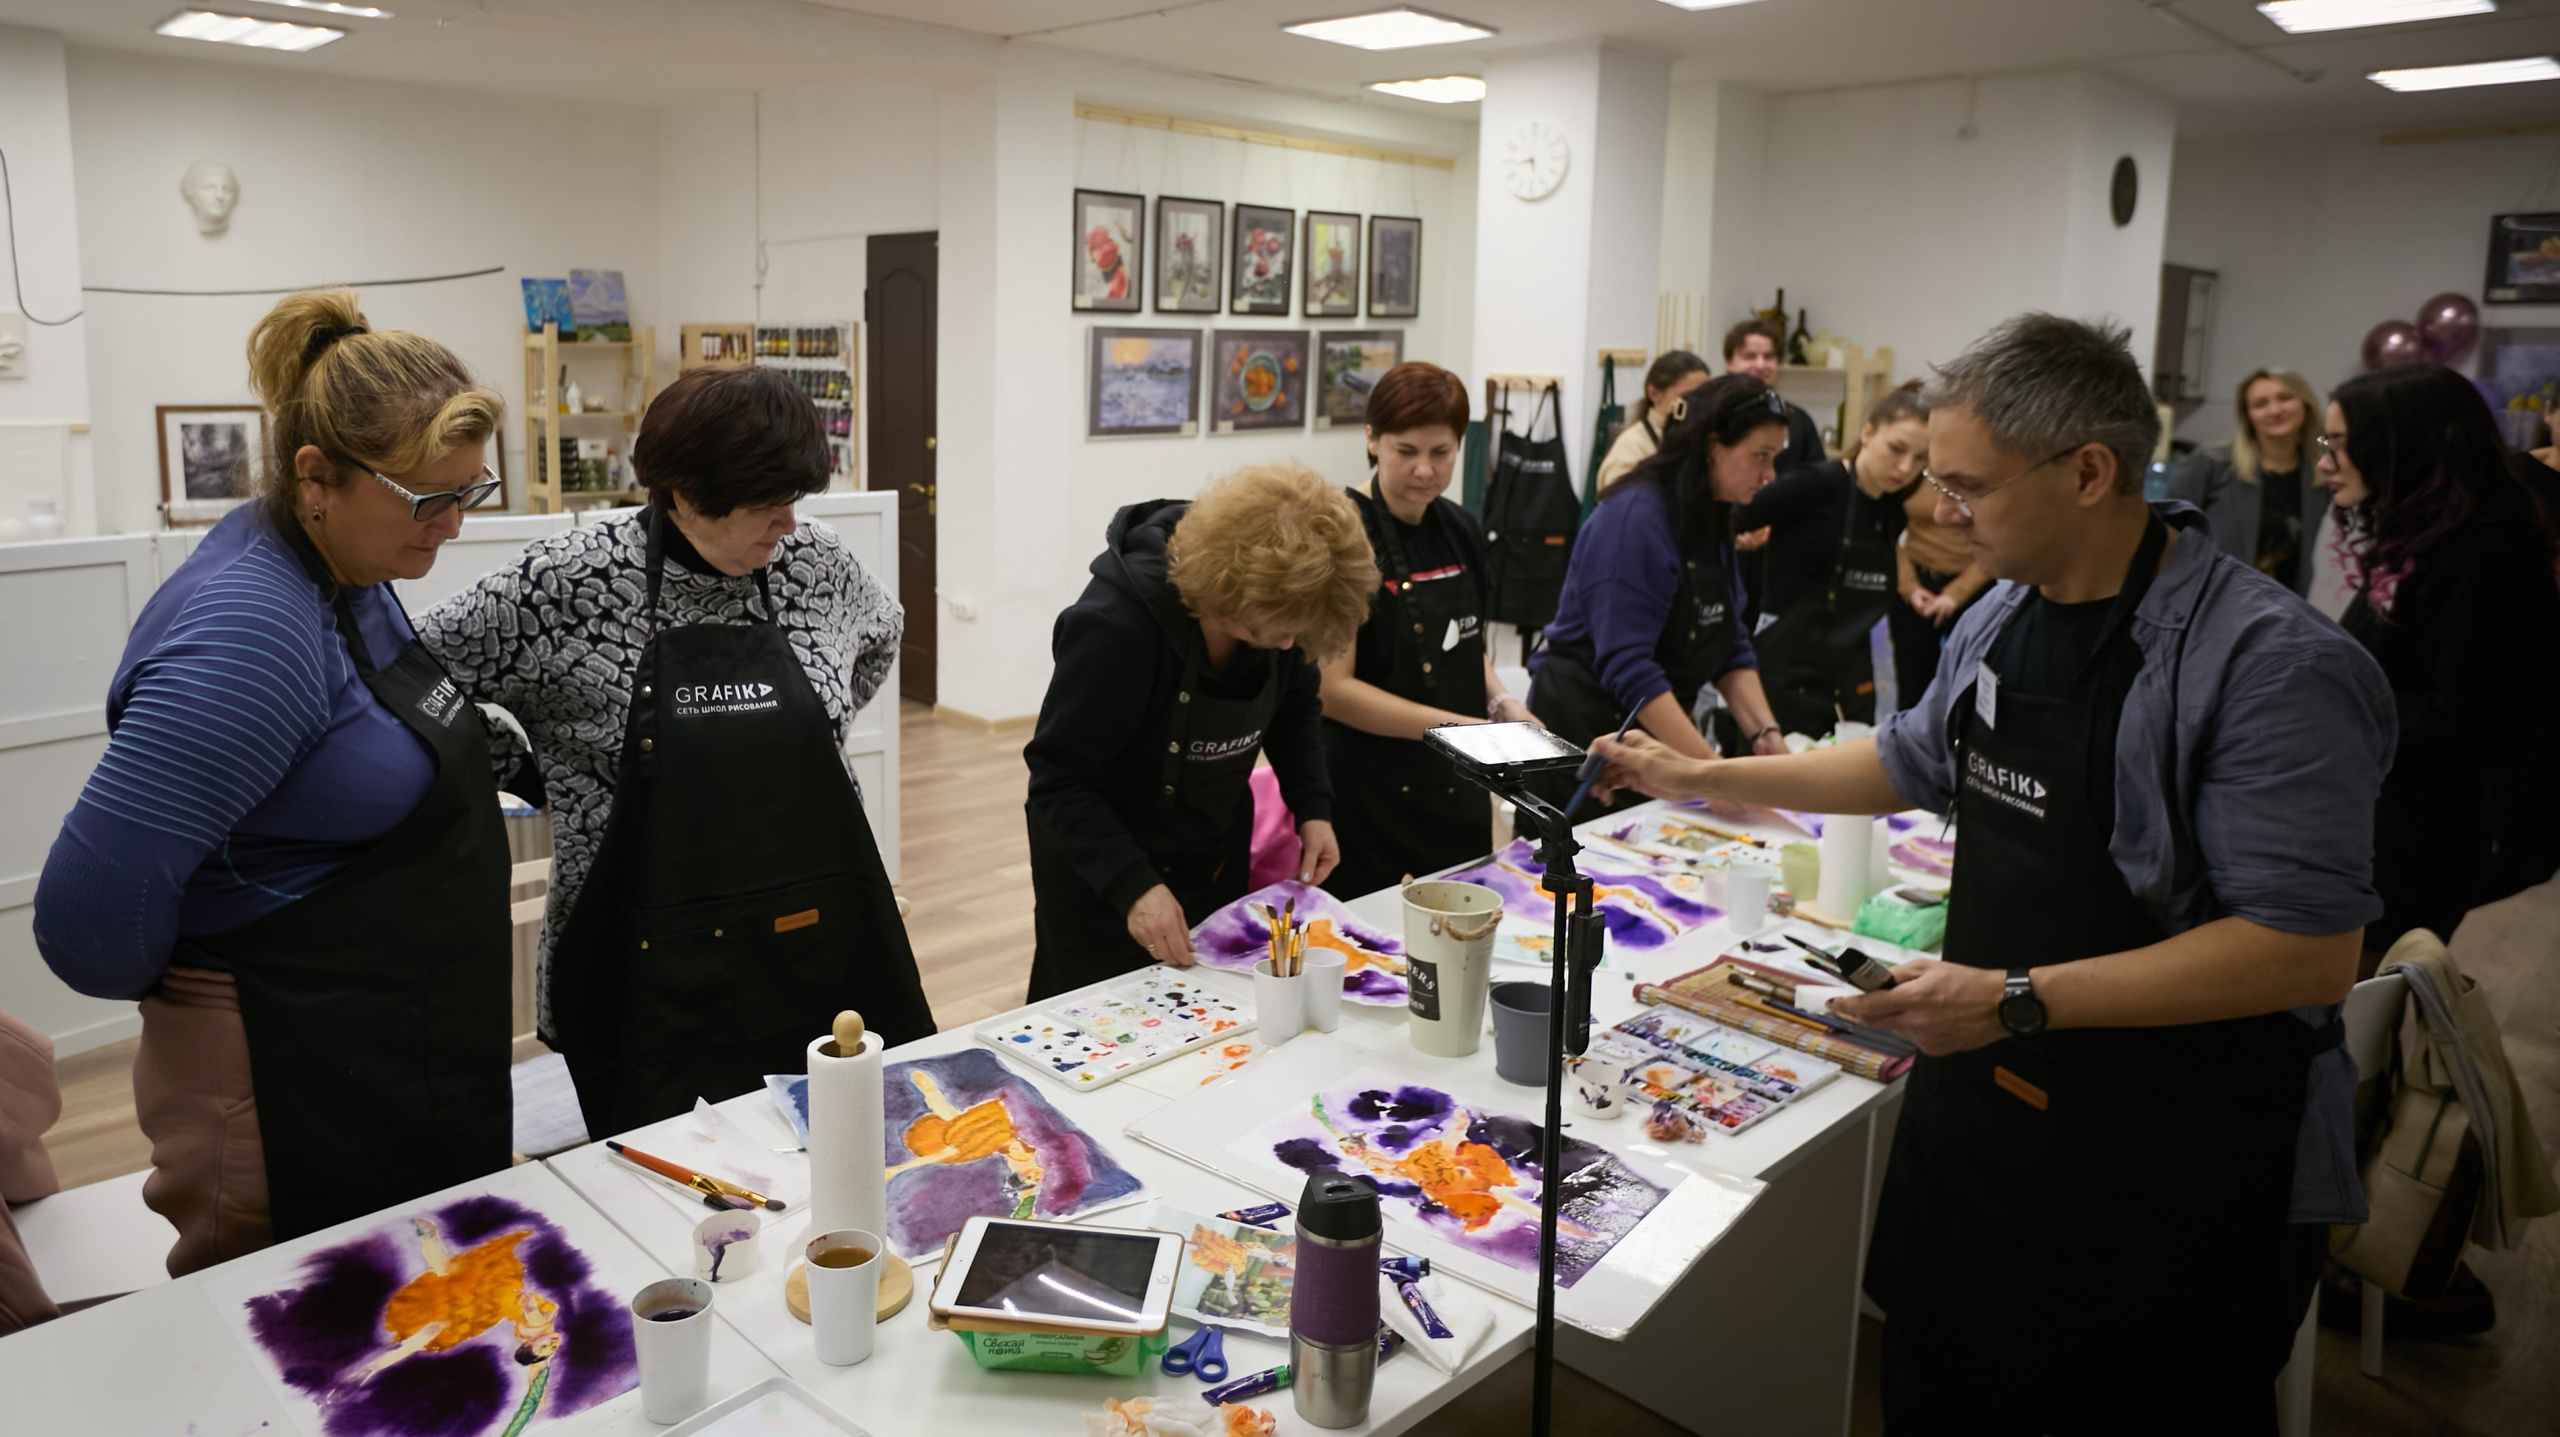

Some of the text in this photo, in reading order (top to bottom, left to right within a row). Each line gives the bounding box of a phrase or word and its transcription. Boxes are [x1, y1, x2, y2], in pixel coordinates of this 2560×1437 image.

[675, 683, 774, 703] GRAFIKA
[676, 699, 778, 715] СЕТЬ ШКОЛ РИСОВАНИЯ
[1968, 752, 2047, 799] GRAFIKA
